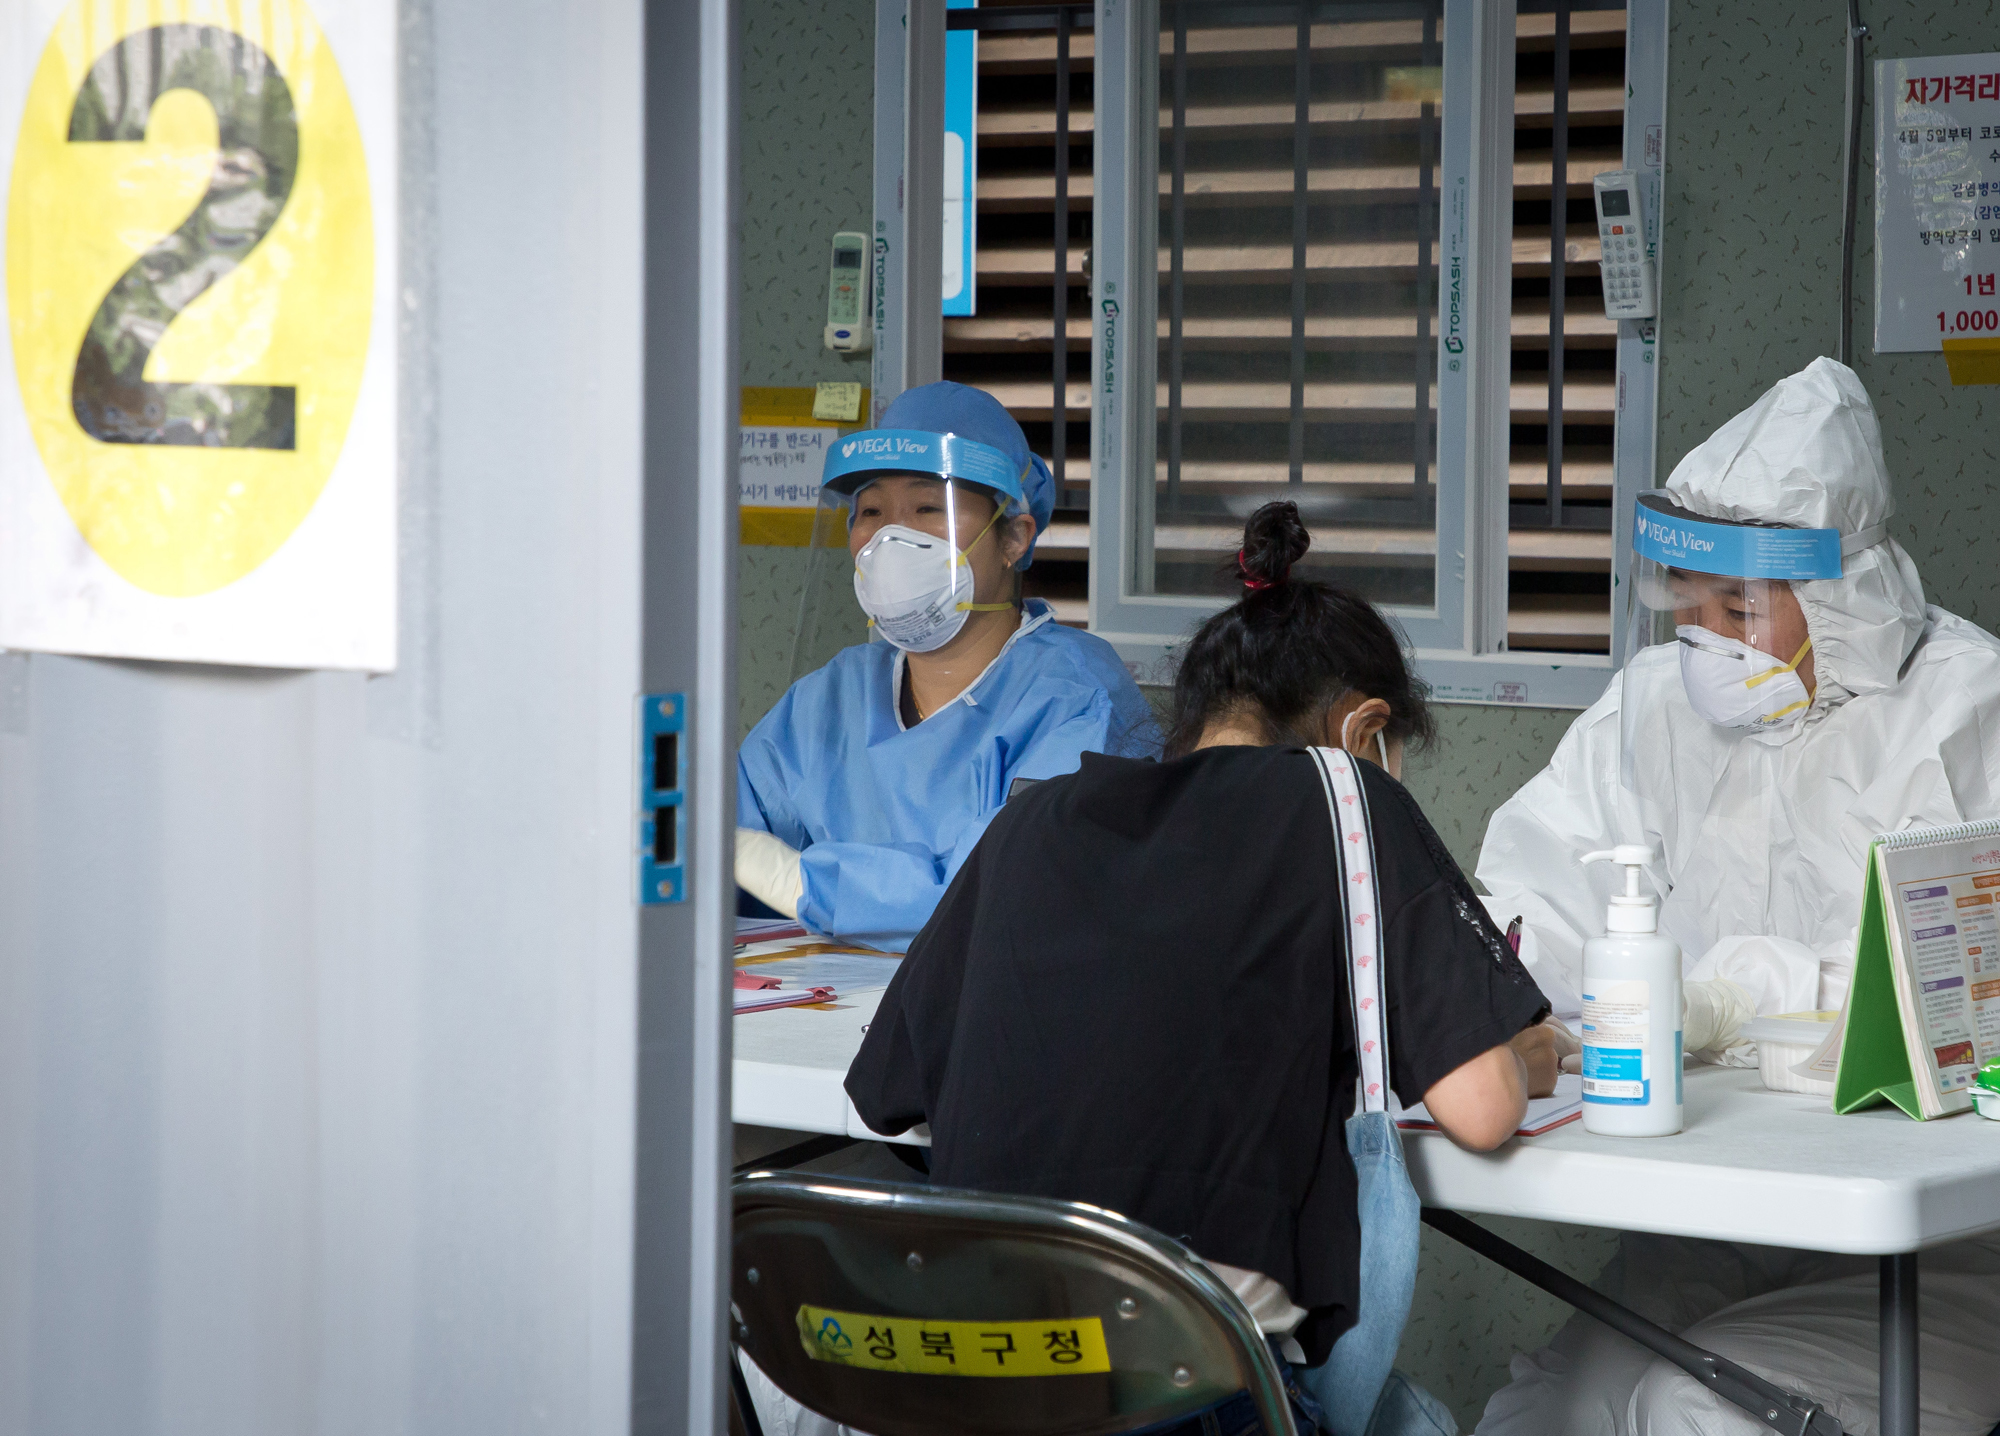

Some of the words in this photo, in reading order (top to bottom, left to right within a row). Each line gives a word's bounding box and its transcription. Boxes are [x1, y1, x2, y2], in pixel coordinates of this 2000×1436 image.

[1905, 73, 2000, 104] 자가격리
[1899, 129, 1919, 144] 4월
[1926, 127, 1972, 142] 5일부터
[66, 22, 299, 450] 2
[1920, 229, 1981, 246] 방역당국의
[876, 256, 886, 330] TOPSASH
[1450, 256, 1461, 335] TOPSASH
[1964, 273, 1995, 296] 1년
[1105, 318, 1115, 394] TOPSASH
[857, 437, 892, 454] VEGA
[896, 437, 929, 454] View
[1647, 520, 1678, 547] VEGA
[1680, 530, 1715, 553] View
